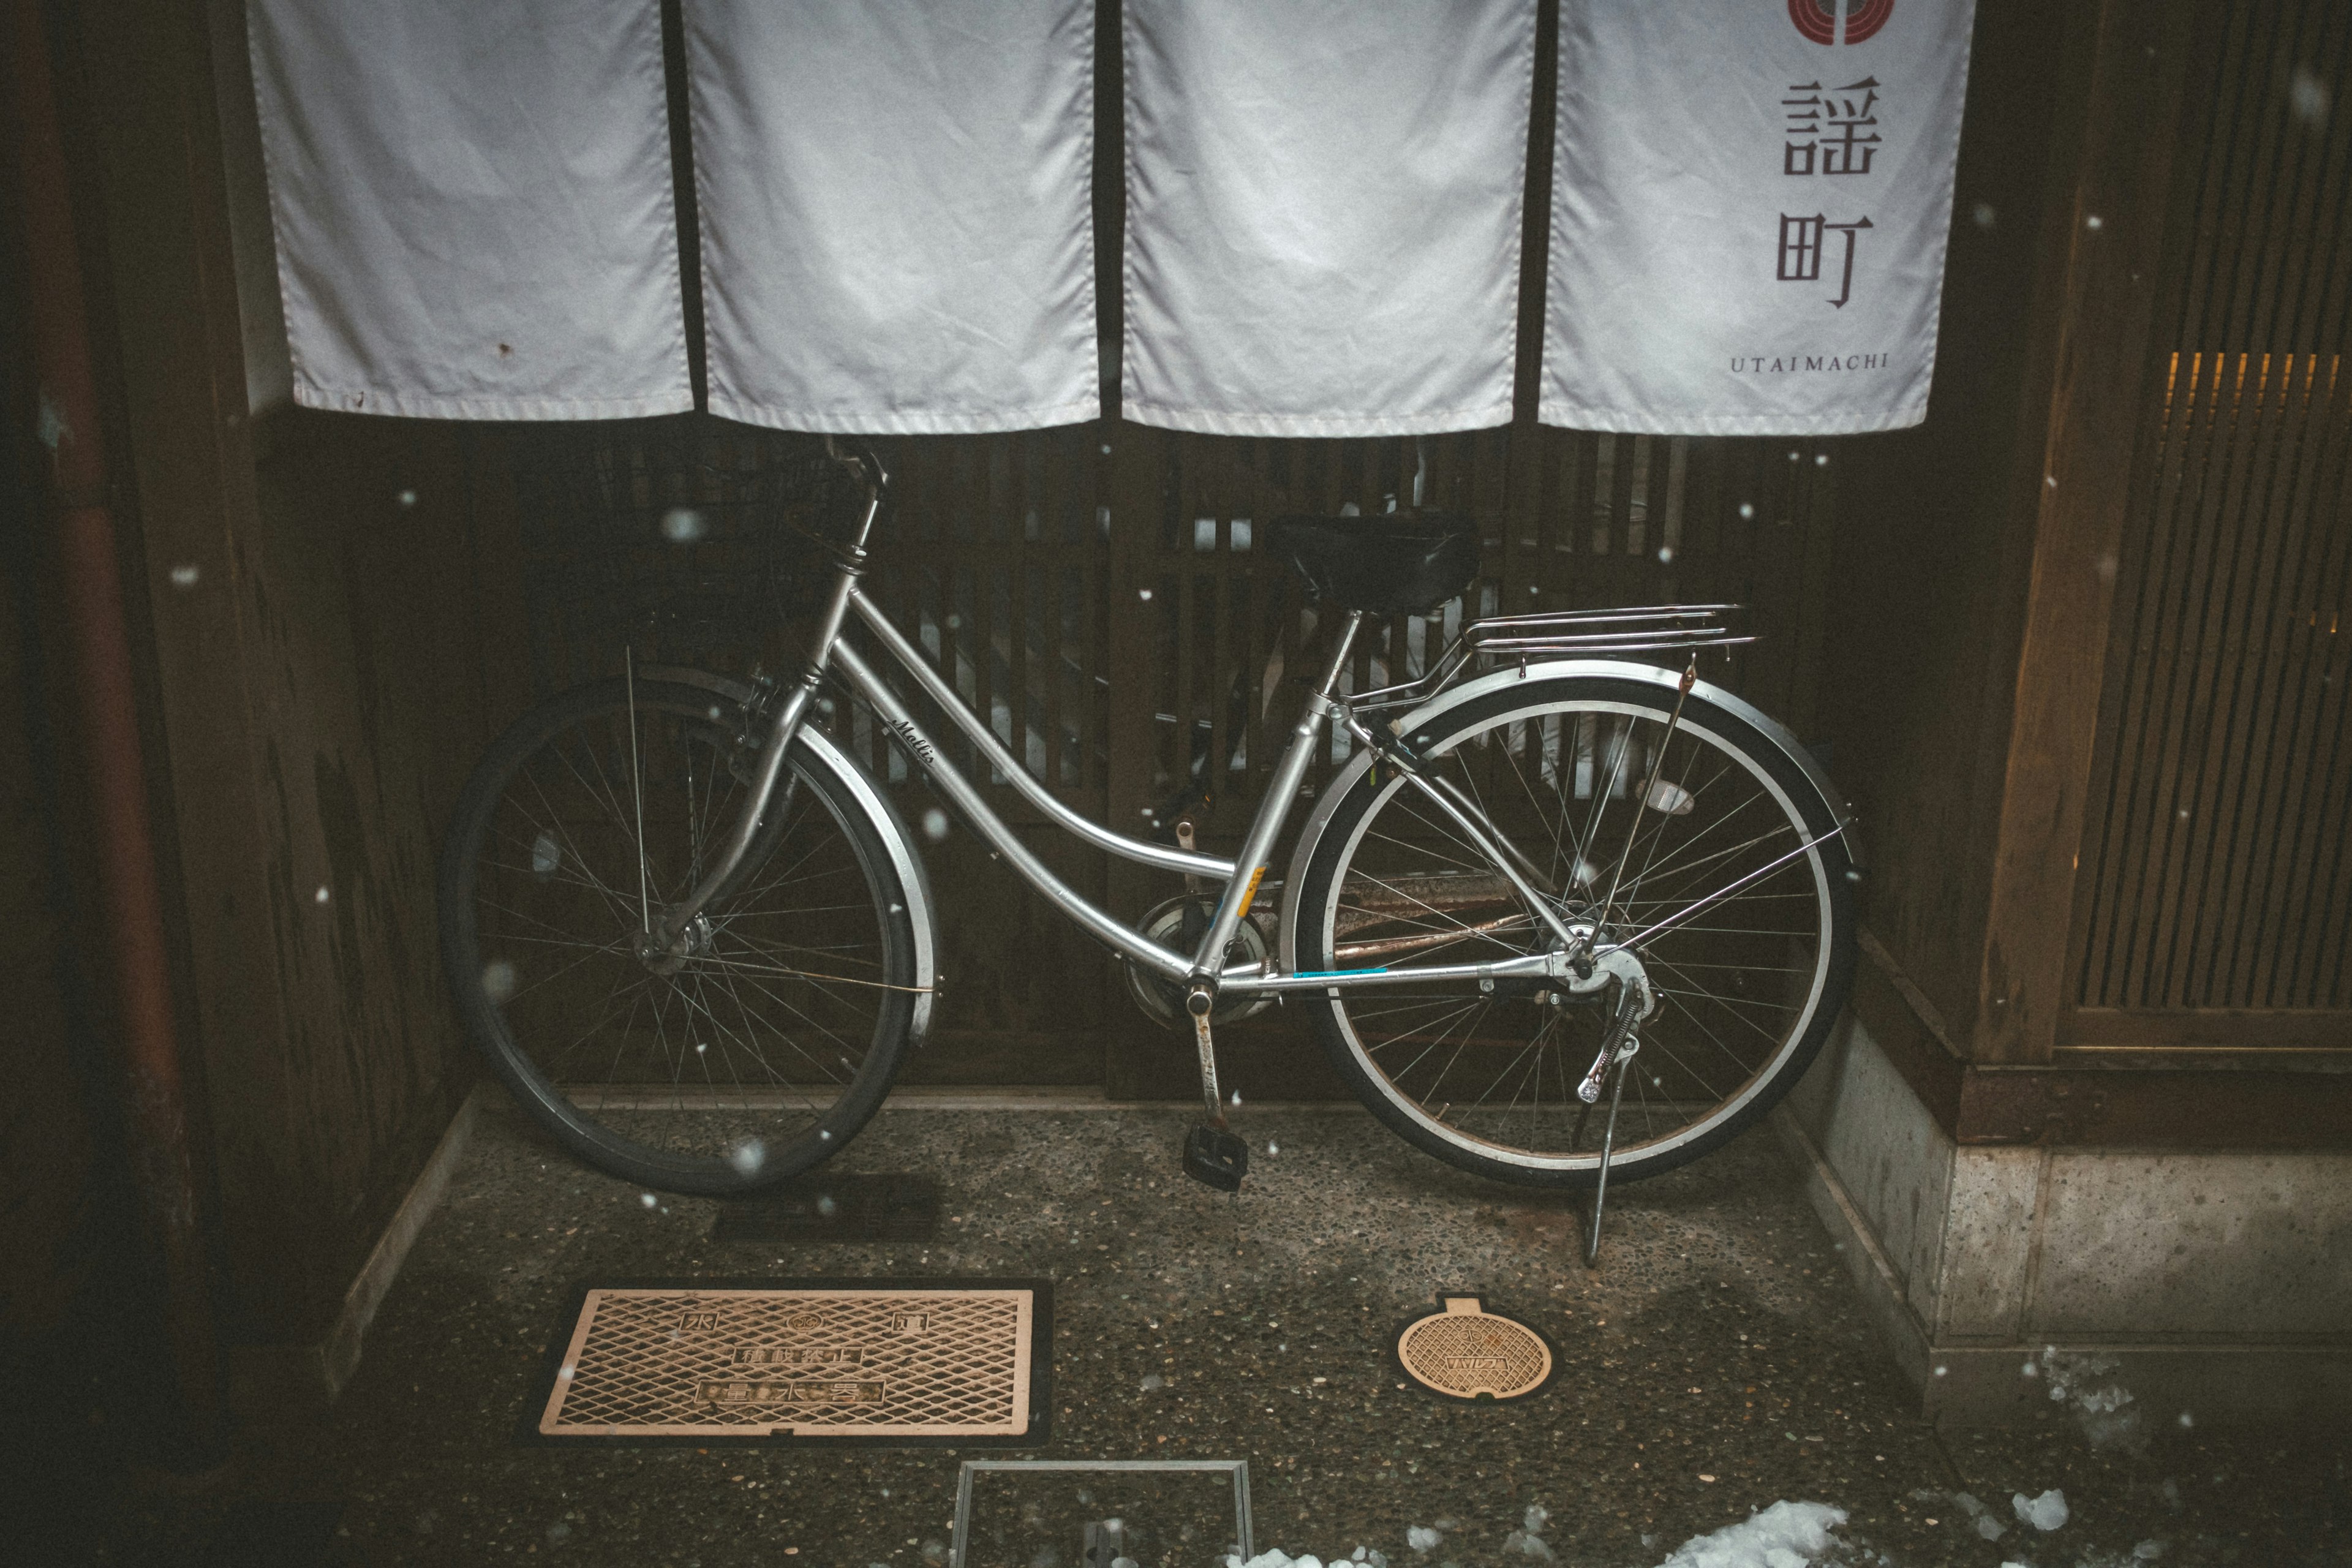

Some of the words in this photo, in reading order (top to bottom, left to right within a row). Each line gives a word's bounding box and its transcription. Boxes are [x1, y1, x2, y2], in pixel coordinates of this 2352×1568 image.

[1776, 75, 1883, 309] 謡町
[1731, 353, 1888, 373] UTAIMACHI
[892, 719, 935, 763] Mollis
[685, 1314, 713, 1330] 水
[1452, 1359, 1504, 1369] バルブ
